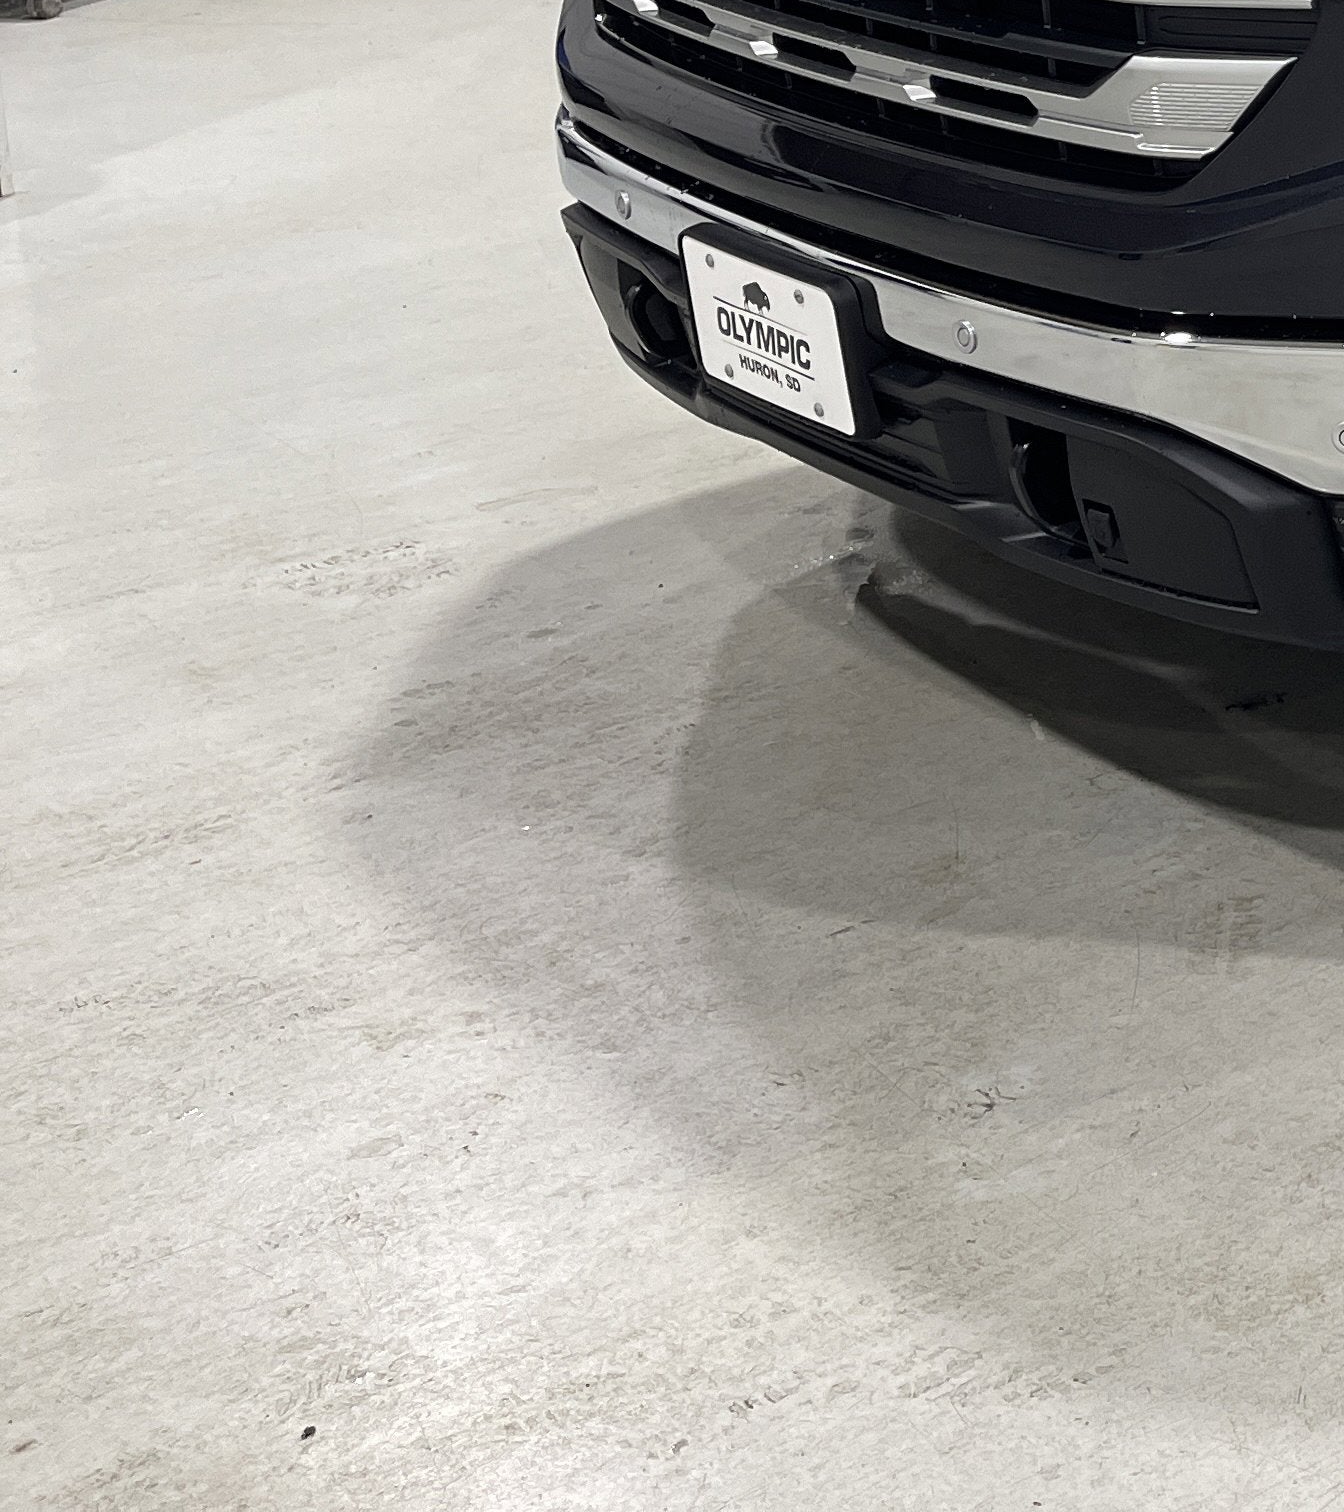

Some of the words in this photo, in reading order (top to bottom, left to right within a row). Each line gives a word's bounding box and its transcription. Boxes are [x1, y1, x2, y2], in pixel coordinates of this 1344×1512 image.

[716, 306, 811, 370] OLYMPIC
[738, 353, 784, 388] HURON,
[784, 373, 801, 393] SD
